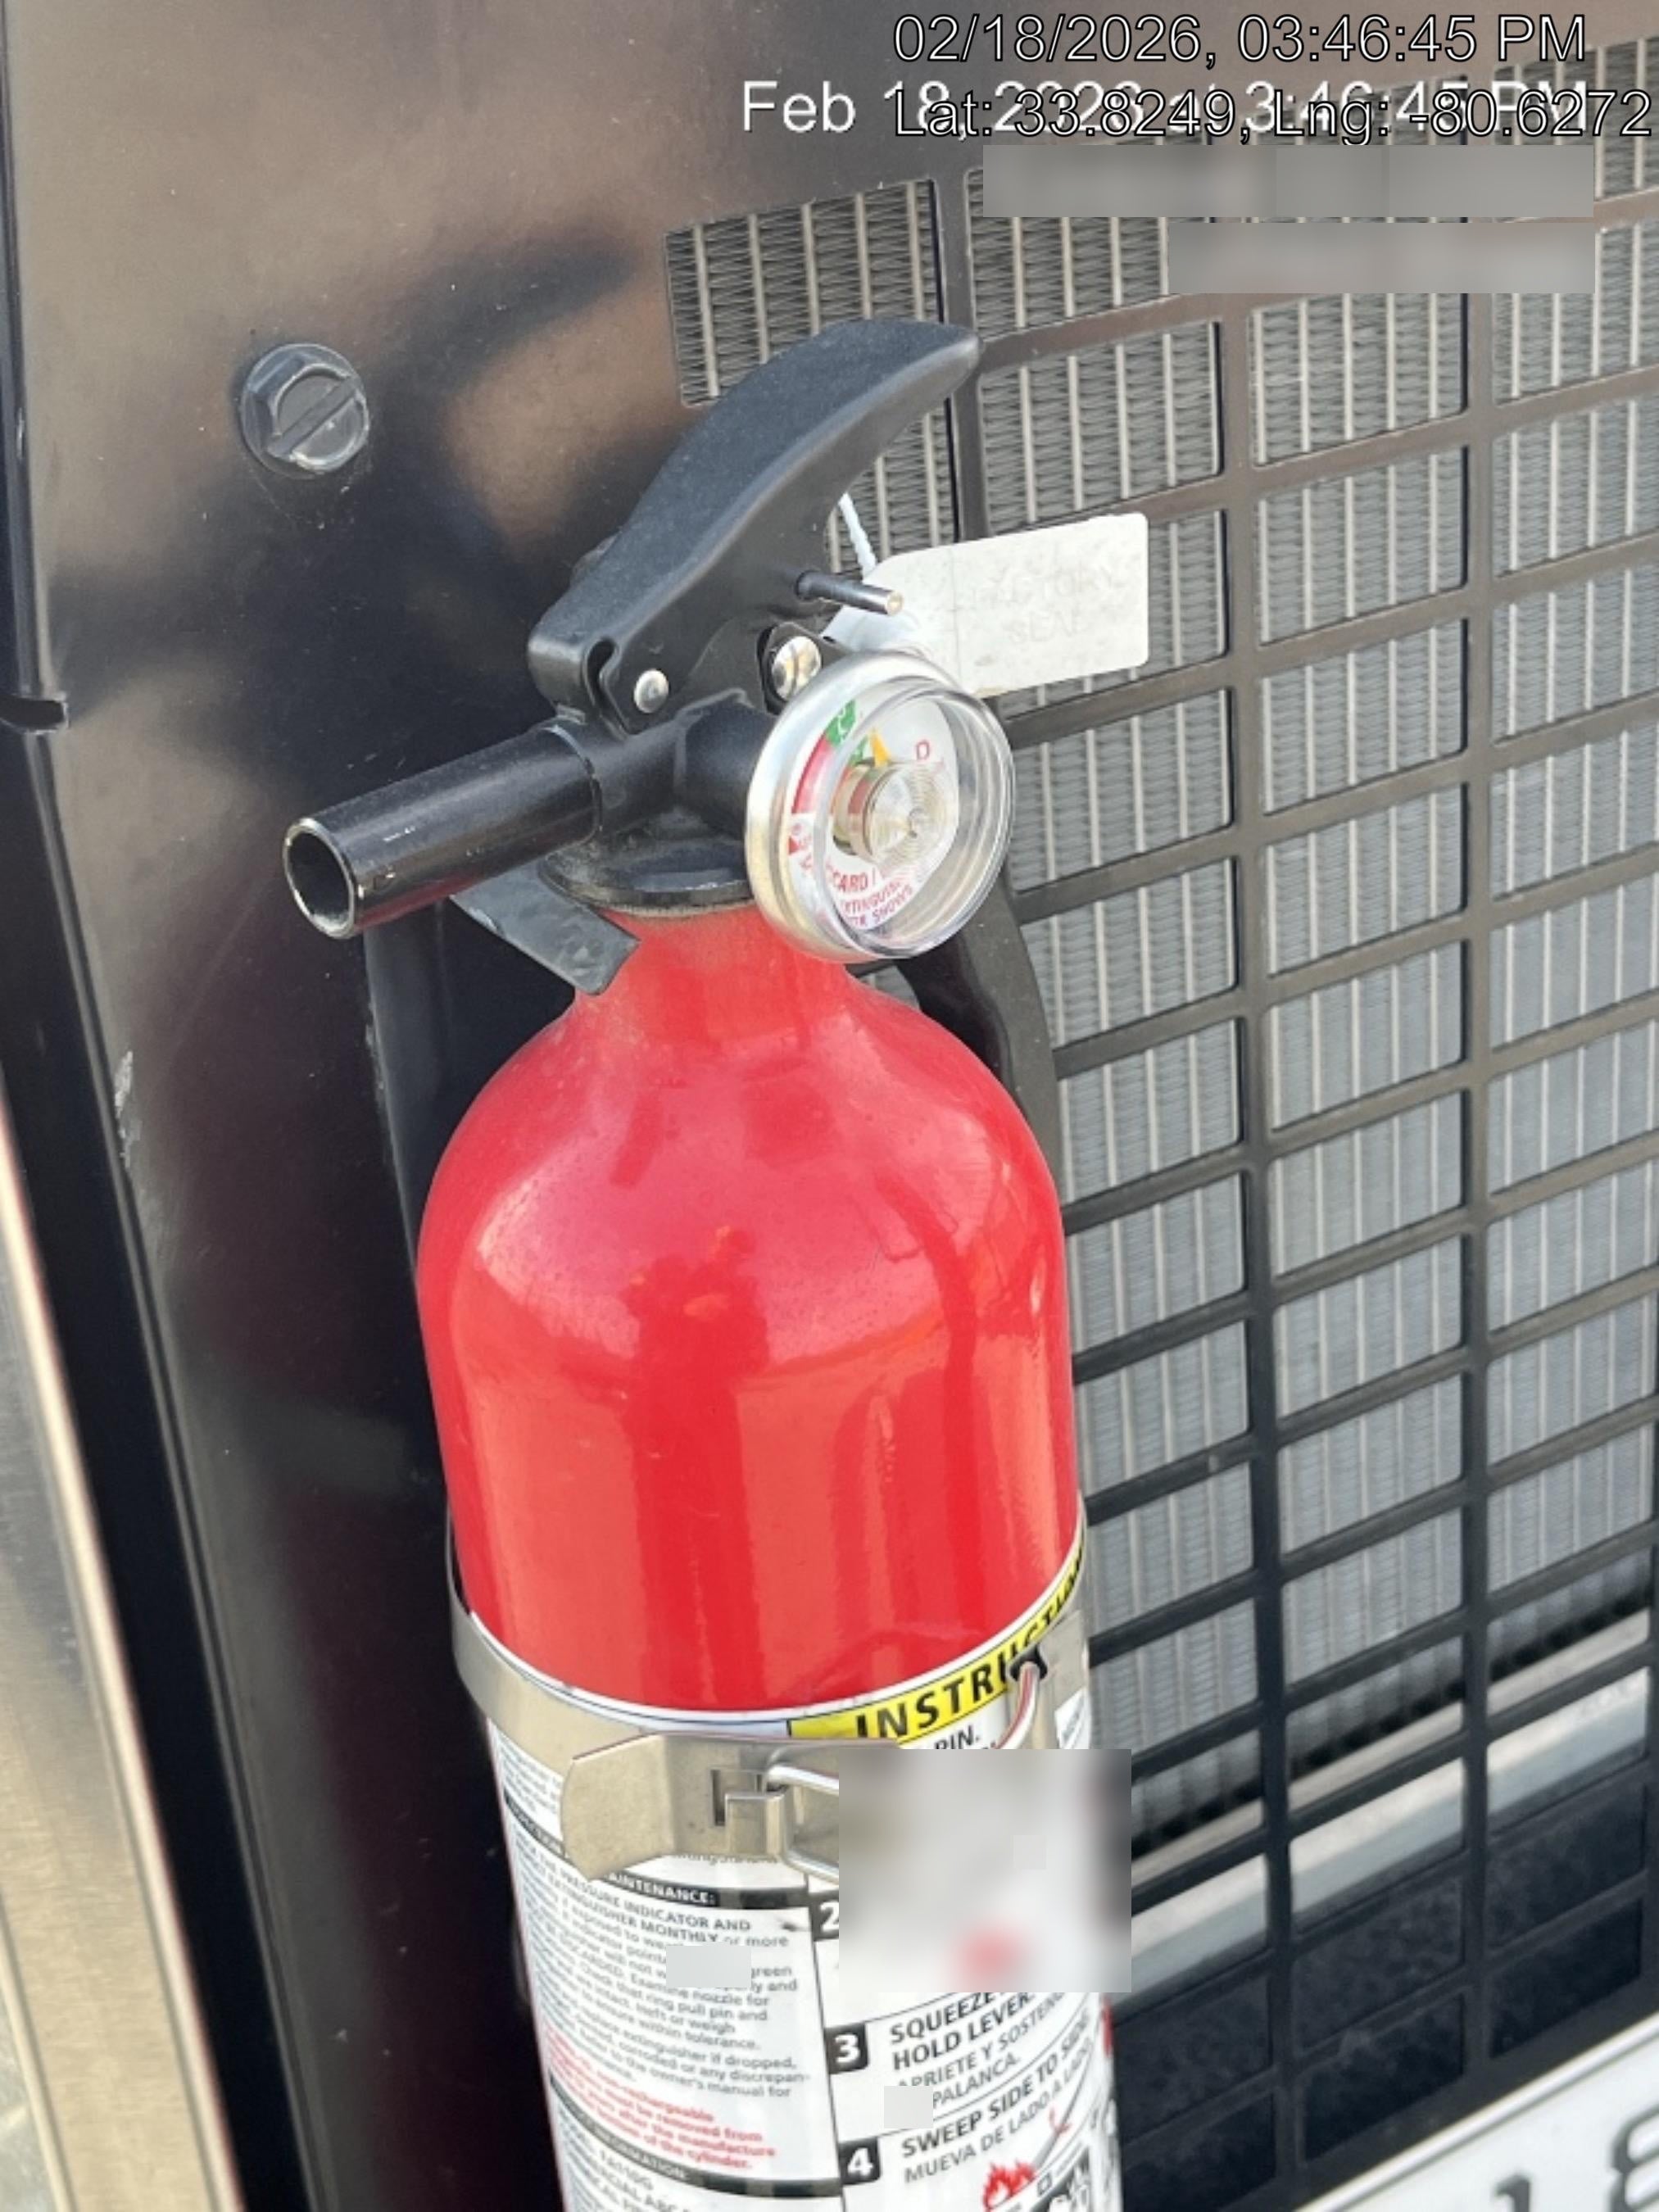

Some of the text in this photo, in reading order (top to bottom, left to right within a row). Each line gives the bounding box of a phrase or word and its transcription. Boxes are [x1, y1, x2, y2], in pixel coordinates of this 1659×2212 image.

[605, 1872, 716, 1904] AINTENANCE:
[623, 1897, 709, 1929] INDICATOR
[713, 1919, 751, 1932] AND
[821, 1901, 839, 1931] 2
[746, 1934, 790, 1947] more
[768, 1979, 797, 1992] and
[738, 2010, 768, 2021] and
[834, 1992, 996, 2064] 3 SQUEEZE
[892, 2031, 962, 2071] HOLD
[980, 2041, 994, 2061] Y
[768, 2086, 791, 2098] for
[846, 2146, 873, 2177] 4
[901, 2108, 982, 2158] SWEEP
[988, 2075, 1034, 2120] SIDE
[1036, 2051, 1058, 2083] TO
[904, 2142, 977, 2184] MUEVA
[981, 2125, 1004, 2152] DE
[1008, 2090, 1050, 2134] LADO
